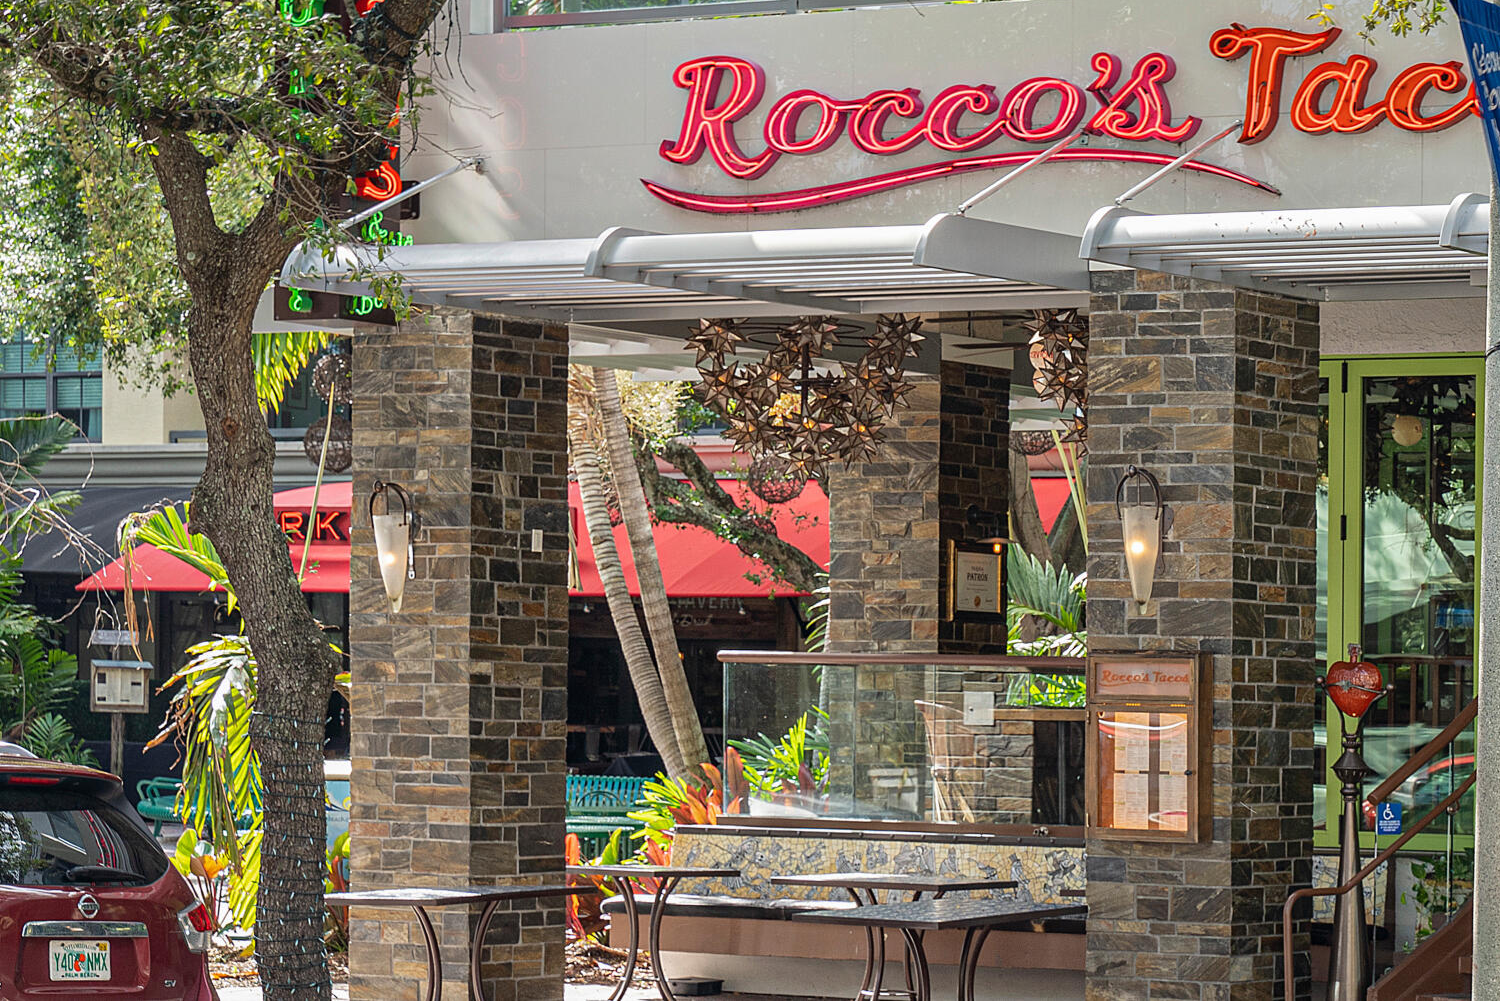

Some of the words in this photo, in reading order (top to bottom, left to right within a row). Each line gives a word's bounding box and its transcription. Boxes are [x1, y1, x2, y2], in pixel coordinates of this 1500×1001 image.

[659, 52, 1202, 180] Rocco's
[1101, 669, 1150, 683] Rocco's
[1152, 671, 1190, 684] Tacos
[87, 952, 108, 972] NMX
